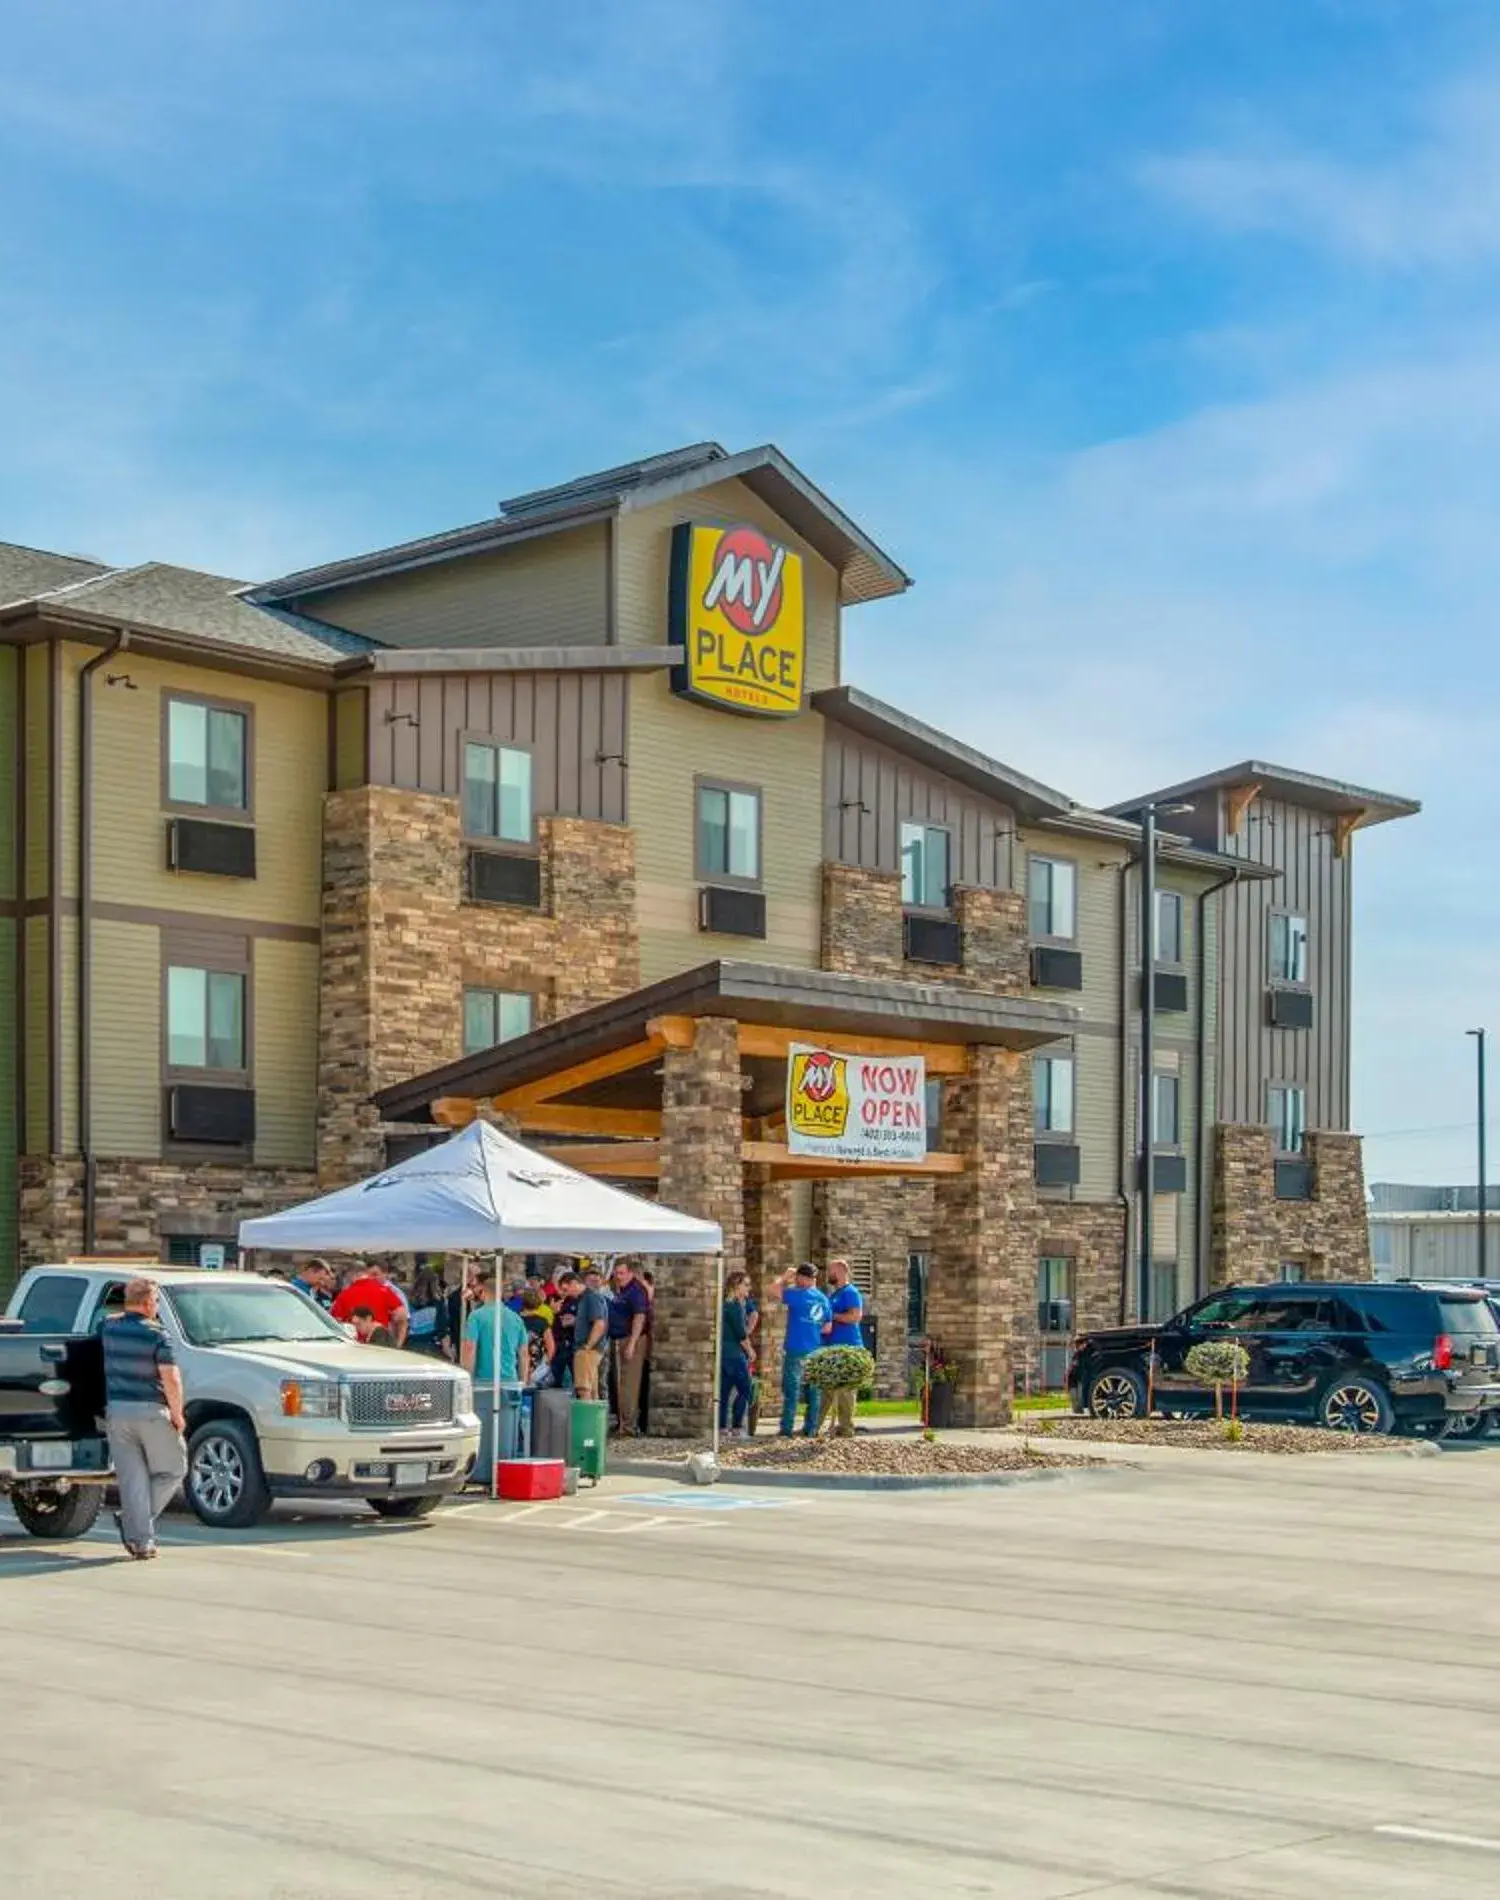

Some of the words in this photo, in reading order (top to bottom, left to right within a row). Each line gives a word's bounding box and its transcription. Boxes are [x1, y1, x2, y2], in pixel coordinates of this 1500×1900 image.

[697, 627, 796, 689] PLACE
[861, 1064, 918, 1096] NOW
[794, 1103, 844, 1125] PLACE
[861, 1098, 922, 1128] OPEN
[385, 1393, 433, 1411] GMC
